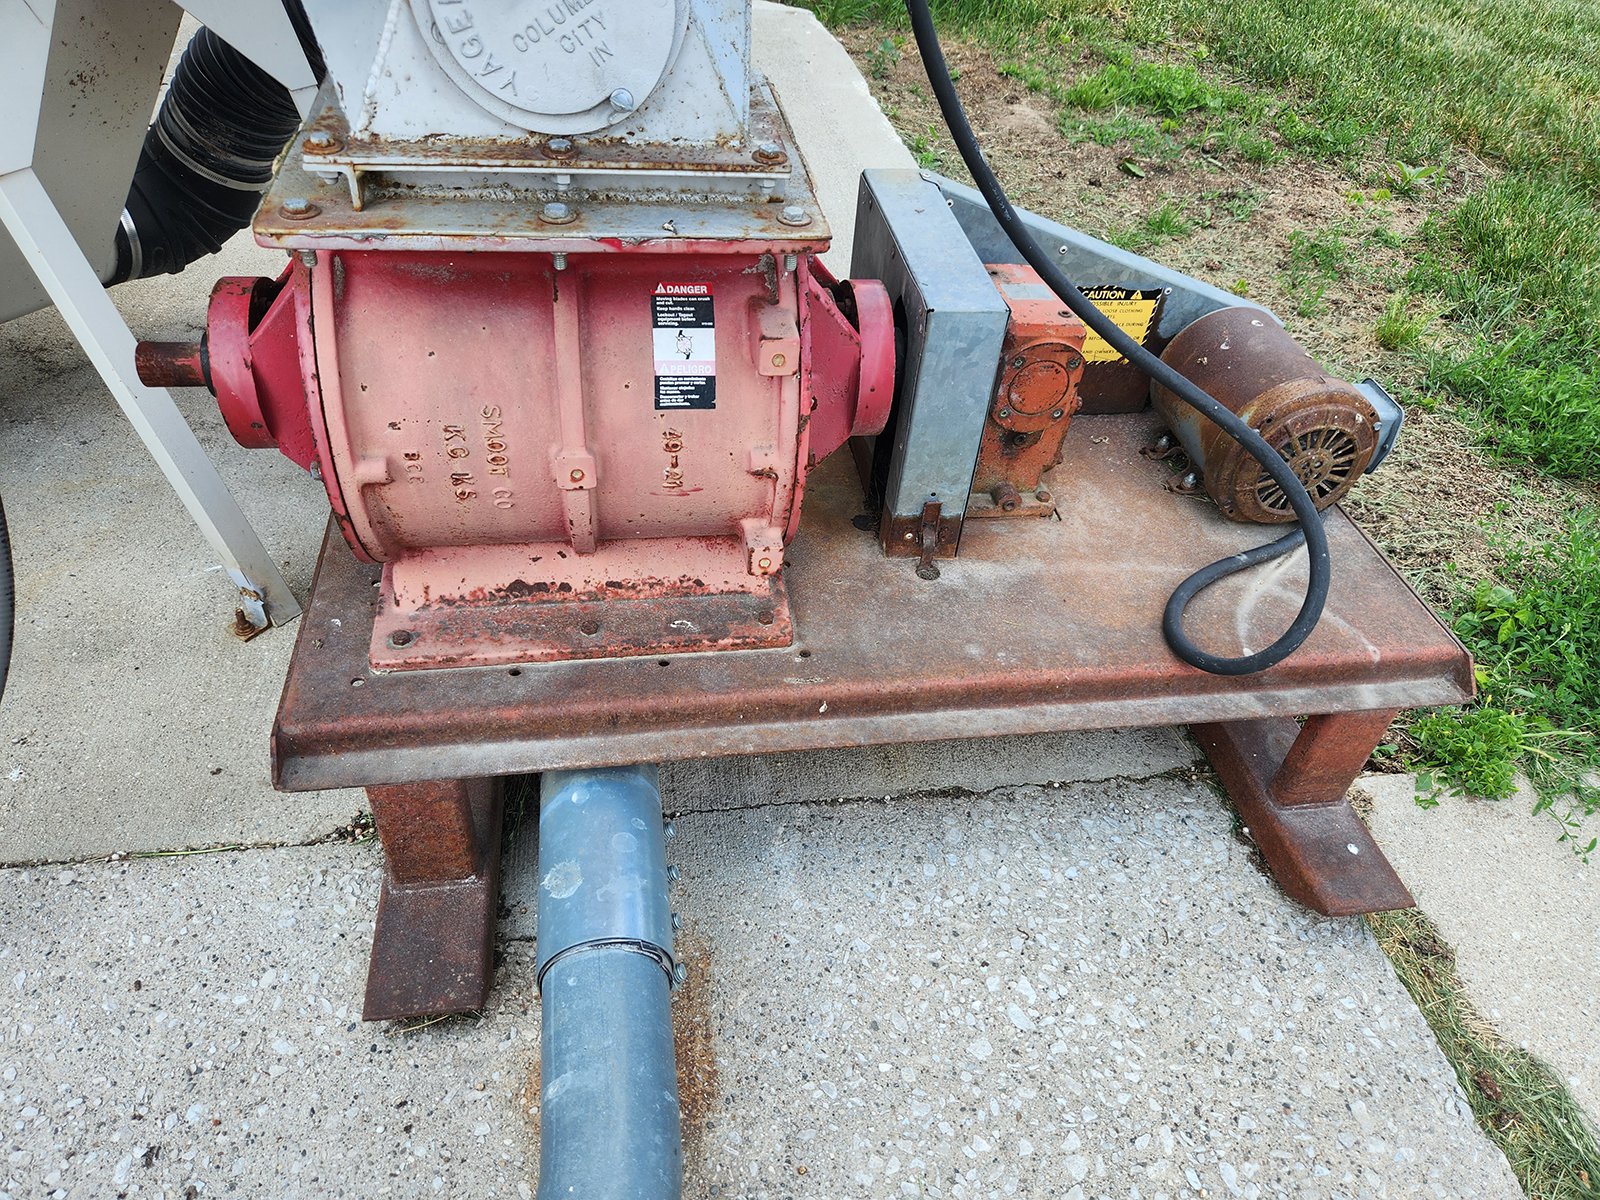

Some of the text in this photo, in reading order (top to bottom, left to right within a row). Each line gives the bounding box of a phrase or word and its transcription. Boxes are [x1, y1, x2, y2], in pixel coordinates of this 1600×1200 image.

[559, 9, 607, 54] CITY
[438, 0, 518, 97] YAGE
[588, 40, 614, 68] IN
[666, 285, 708, 294] DANGER
[1082, 290, 1126, 299] CAUTION
[670, 364, 712, 374] PELIGRO
[481, 404, 515, 509] SMOOT CO
